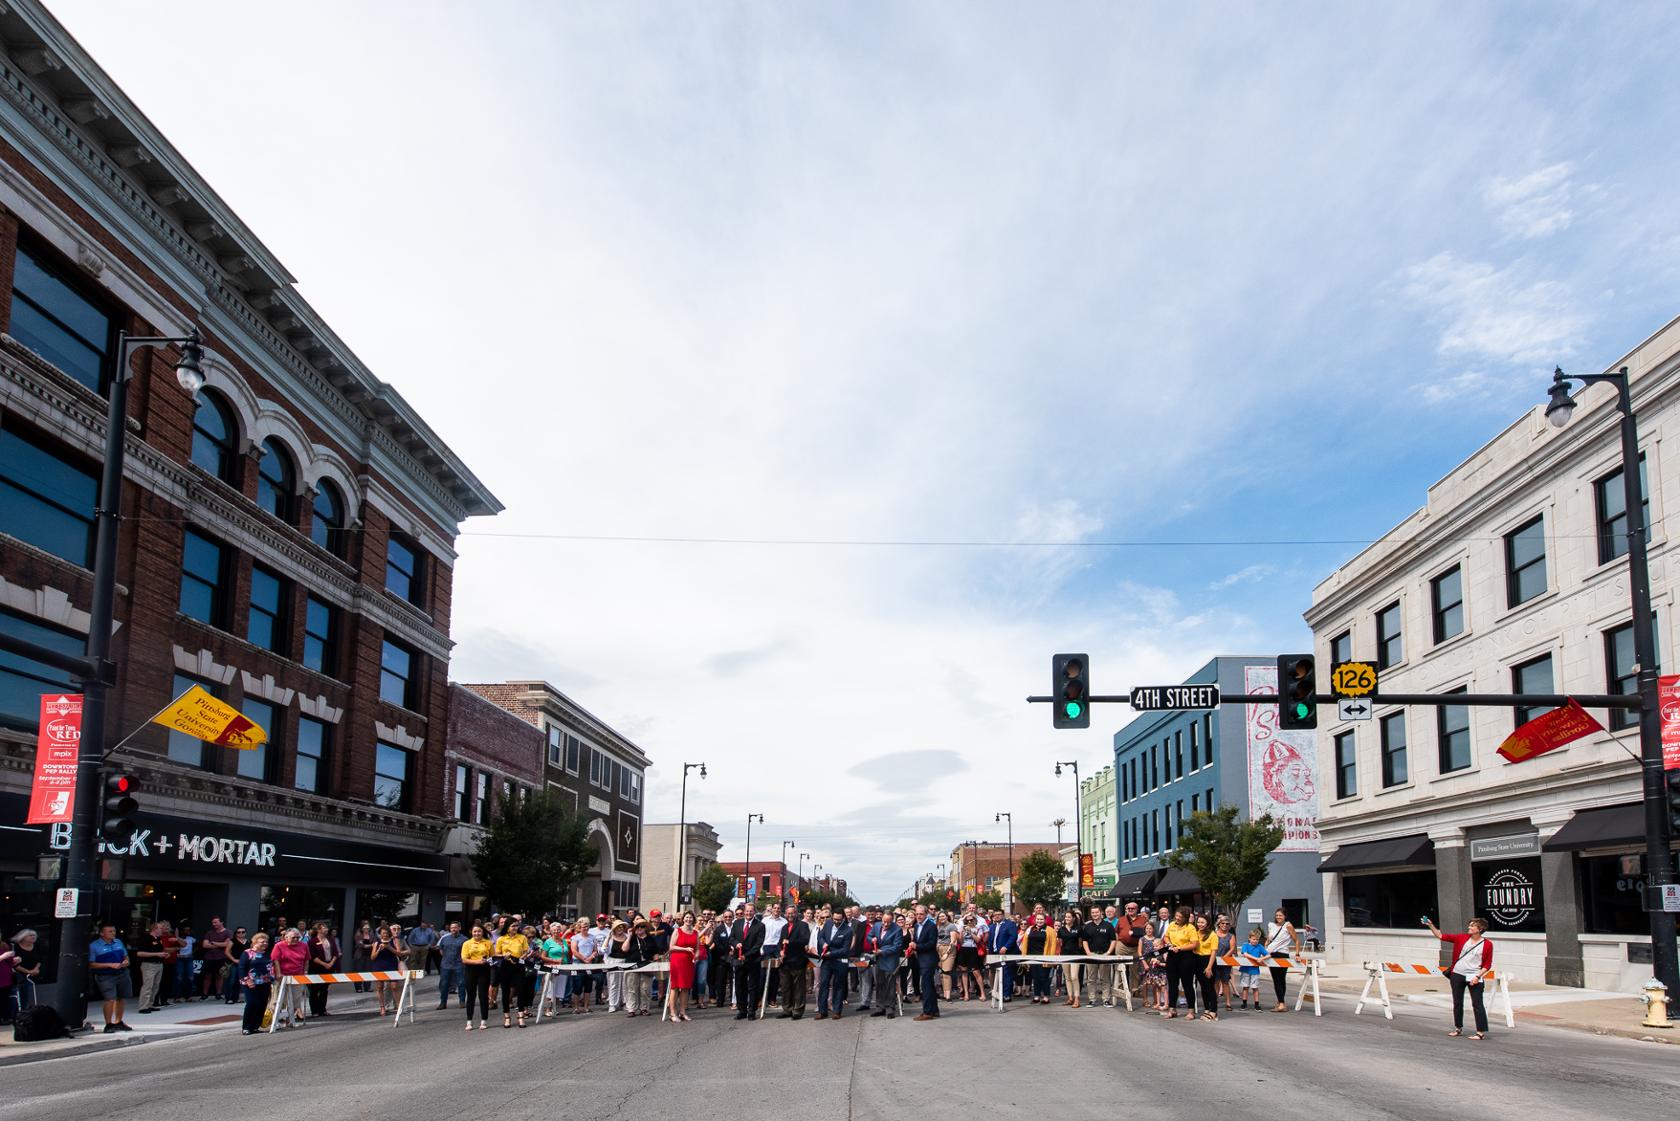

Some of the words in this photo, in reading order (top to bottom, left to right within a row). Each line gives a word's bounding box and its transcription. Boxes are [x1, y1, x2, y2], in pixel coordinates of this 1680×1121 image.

[1338, 669, 1371, 689] 126
[1135, 691, 1160, 708] 4TH
[1166, 687, 1213, 707] STREET
[195, 697, 231, 720] Pittsburg
[196, 710, 219, 724] State
[176, 708, 220, 736] University
[56, 731, 81, 739] RED
[54, 750, 73, 758] mpix
[49, 822, 151, 857] BICK
[178, 833, 276, 867] MORTAR
[1487, 887, 1533, 906] FOUNDRY
